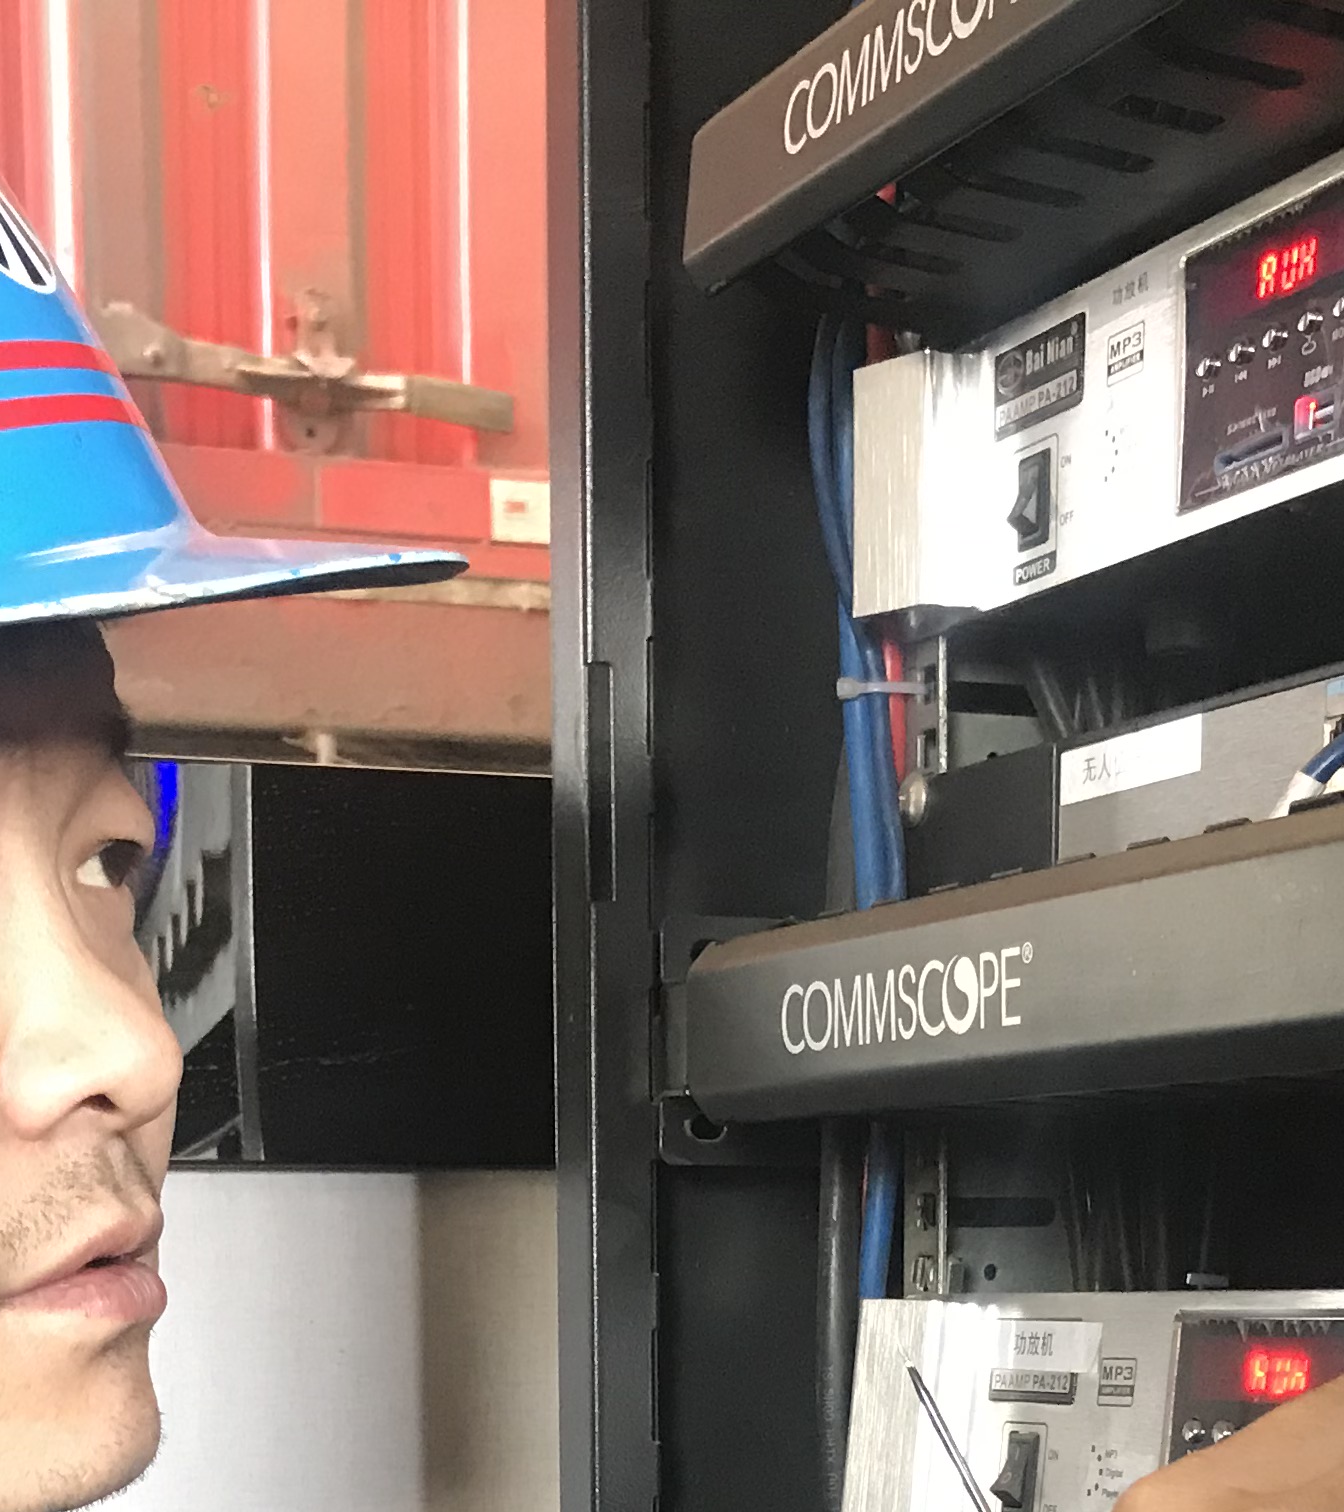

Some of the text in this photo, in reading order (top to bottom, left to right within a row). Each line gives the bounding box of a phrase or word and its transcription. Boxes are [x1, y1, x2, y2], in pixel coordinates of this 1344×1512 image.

[784, 0, 1017, 154] COMMSCO
[1109, 331, 1142, 360] MP3
[1060, 455, 1072, 469] ON
[1059, 510, 1074, 527] OFF
[1015, 557, 1051, 584] POWER
[1014, 1331, 1054, 1357] 功放机
[1032, 1374, 1069, 1391] PA-212
[1102, 1366, 1134, 1381] MP3
